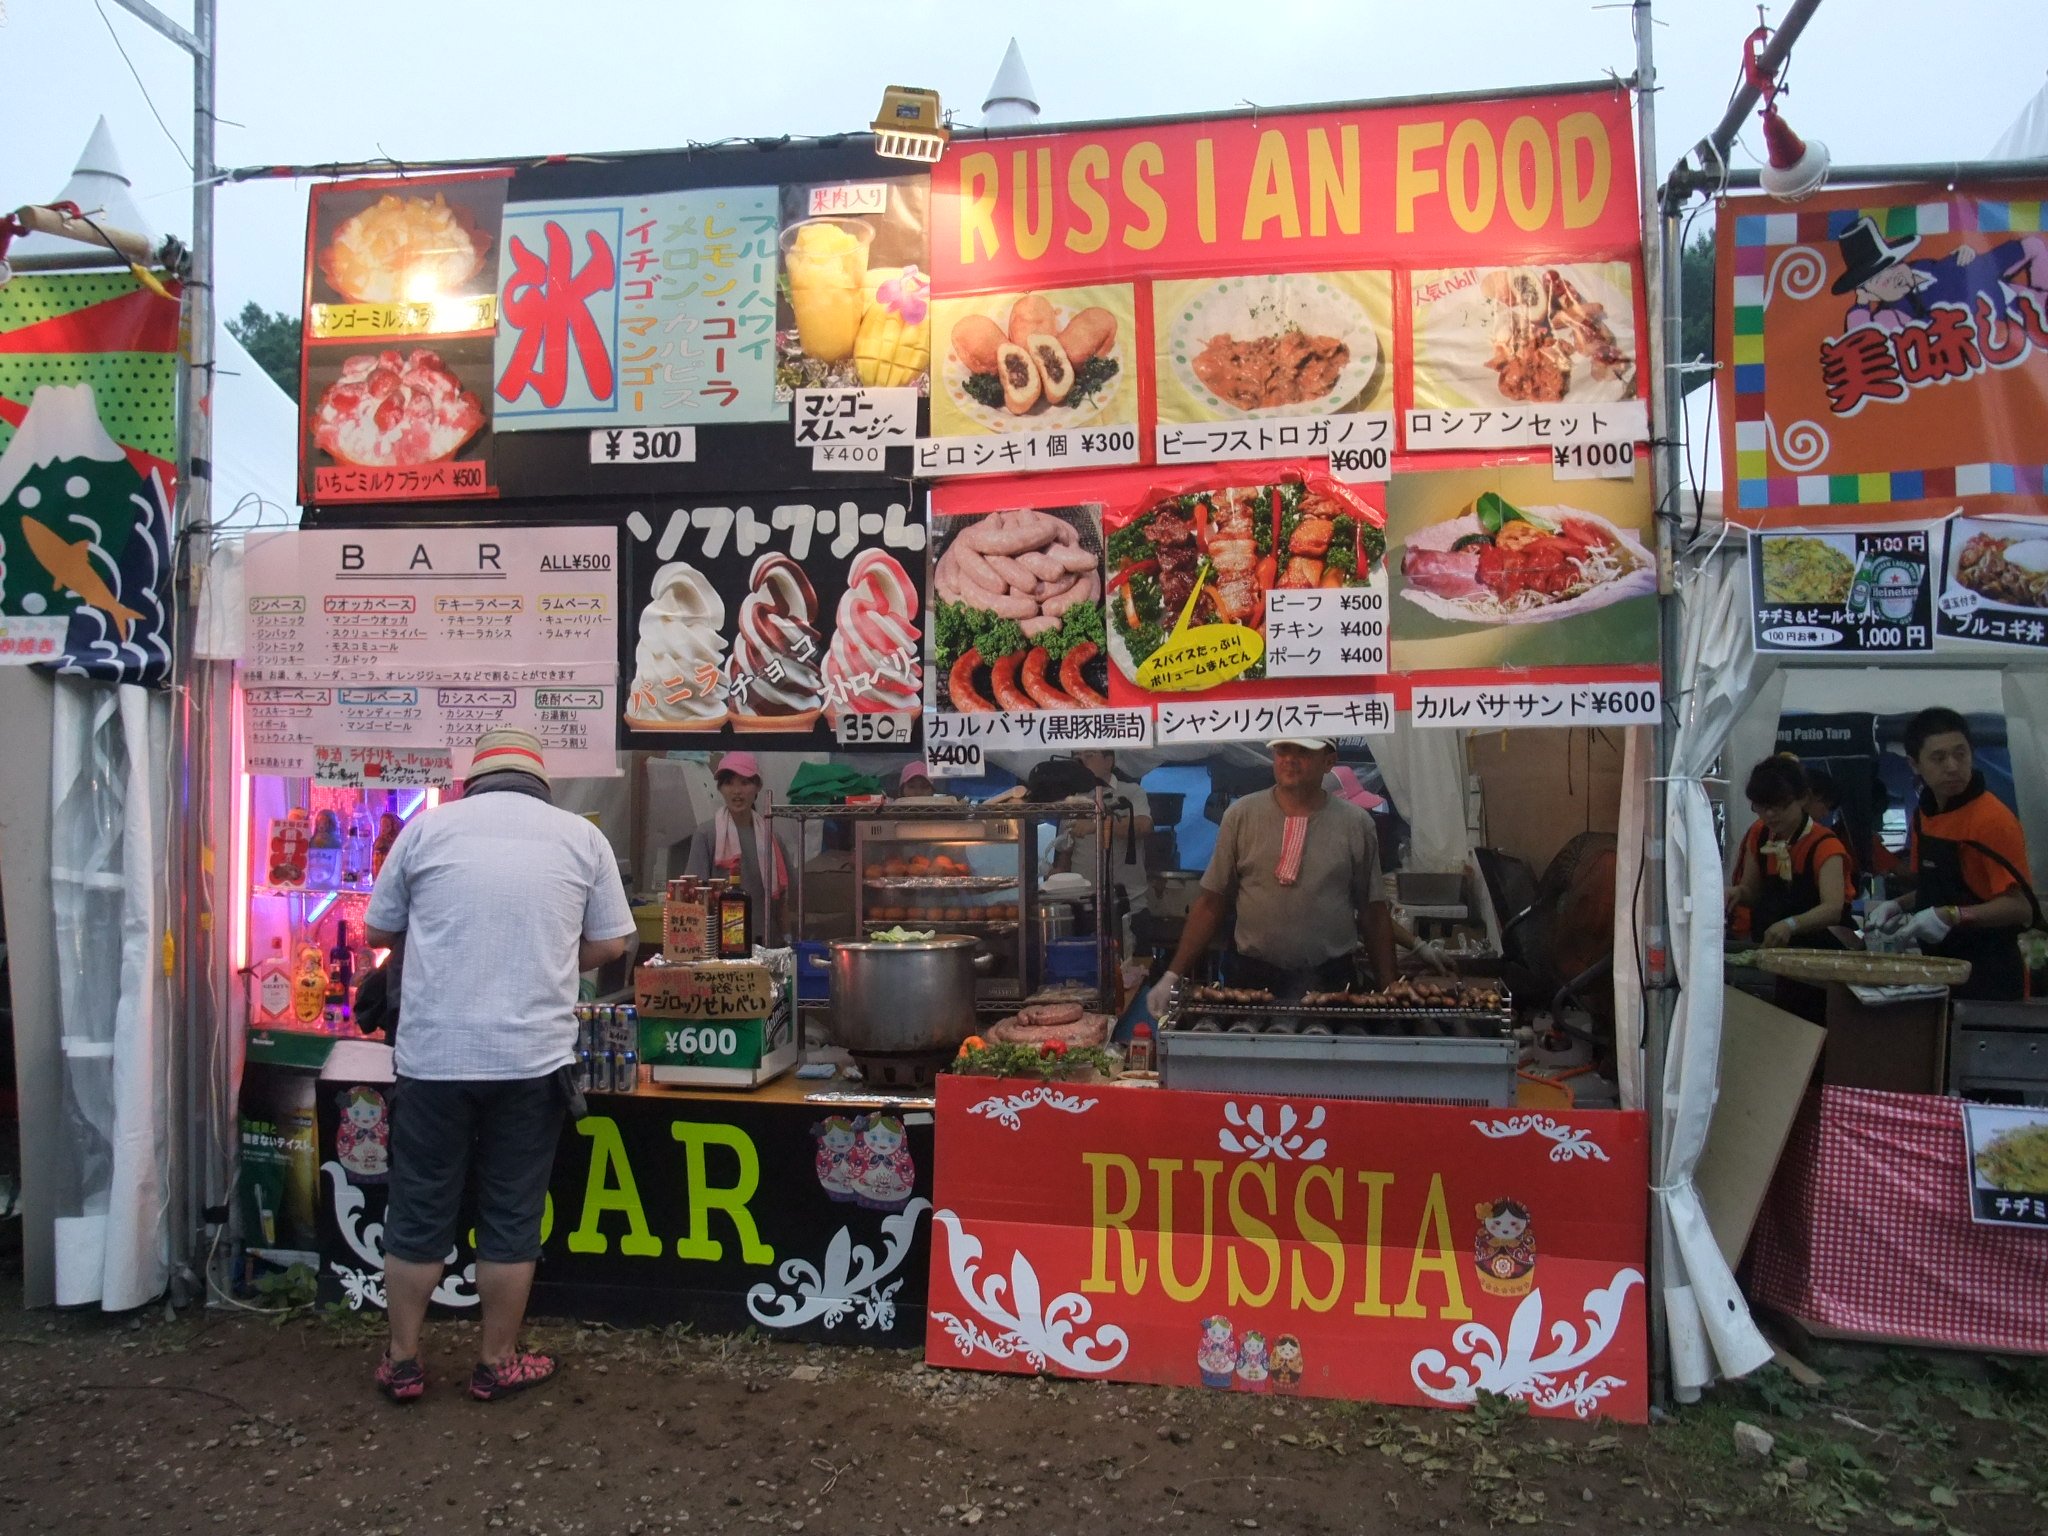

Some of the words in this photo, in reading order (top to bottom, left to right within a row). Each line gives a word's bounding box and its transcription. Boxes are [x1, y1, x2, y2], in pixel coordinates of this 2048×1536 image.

[812, 188, 881, 212] 果肉入り
[959, 122, 1360, 265] RUSSIAN
[1396, 111, 1612, 234] FOOD
[495, 220, 615, 408] 氷
[804, 391, 873, 418] マンゴー
[1412, 411, 1608, 436] ロシアンセット
[606, 430, 681, 459] ¥300
[920, 434, 1067, 468] ピロシキ1個
[1081, 431, 1135, 453] ¥300
[1163, 420, 1388, 455] ビーフストロガノフ
[823, 447, 878, 462] ¥400
[1331, 447, 1387, 471] ¥600
[1555, 442, 1633, 467] ¥1000
[317, 469, 445, 492] いちごミルクフラッペ
[453, 468, 482, 486] ¥500
[626, 502, 926, 561] ソフトクリーム
[540, 554, 611, 570] ALL¥500
[541, 598, 601, 610] ラムベース
[1271, 594, 1323, 612] ビーフ
[1340, 594, 1383, 611] ¥500
[1872, 586, 1919, 598] Heineken
[251, 600, 302, 611] ジンベース
[327, 599, 411, 611] ウオッカベース
[438, 599, 521, 611] テキーラベース
[1758, 609, 1880, 625] チヂミ&ビールセット
[1269, 620, 1324, 639] チキン
[1340, 620, 1383, 637] ¥400
[1152, 635, 1241, 670] スパイスたっぷり
[1269, 645, 1322, 666] ポーク
[1340, 647, 1383, 663] ¥400
[730, 636, 816, 703] チョコ
[817, 647, 921, 711] ストロベリー
[1151, 651, 1252, 687] ボリュームまんてん
[440, 693, 512, 704] カシスベース
[538, 693, 598, 705] 焼酎ベース
[632, 663, 719, 714] バニラ
[446, 709, 503, 719] カシスソーダ
[1163, 699, 1390, 734] シャシリク(ステーキ串)
[446, 722, 512, 733] カシスオレ
[541, 723, 587, 734] ソーダ割り
[843, 714, 907, 742] 350円
[928, 712, 1146, 744] カルバサ(黒豚腸詰)
[1794, 728, 1824, 740] Patio
[1825, 727, 1851, 741] Tarp
[928, 744, 981, 766] ¥400
[640, 990, 767, 1015] フジロックせんべい
[665, 1028, 736, 1056] ¥600
[1996, 1197, 2046, 1219] チヂミ
[1081, 1152, 1473, 1320] RUSSIA
